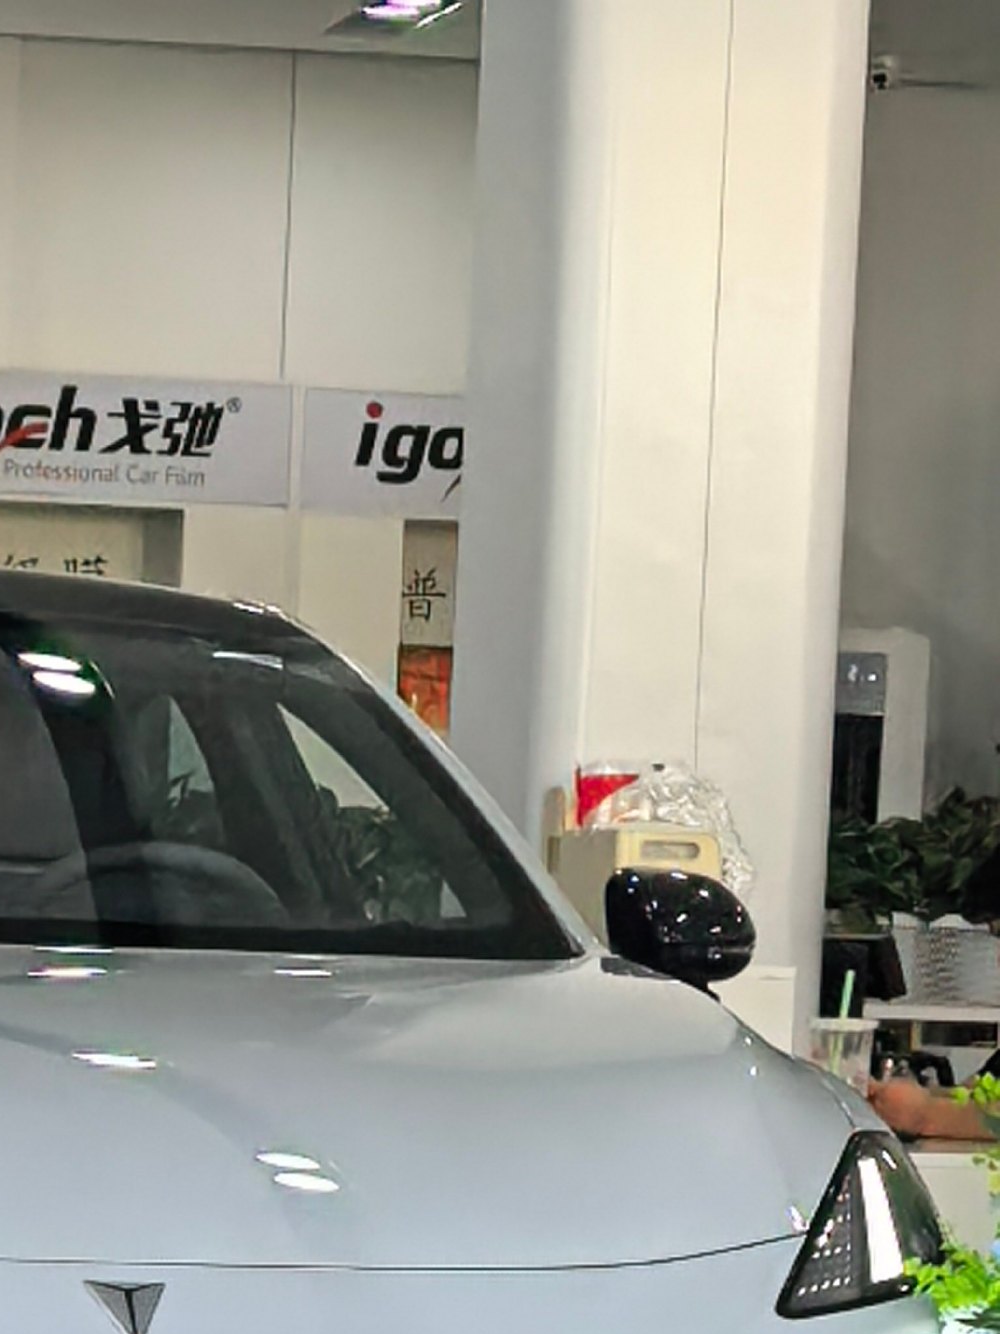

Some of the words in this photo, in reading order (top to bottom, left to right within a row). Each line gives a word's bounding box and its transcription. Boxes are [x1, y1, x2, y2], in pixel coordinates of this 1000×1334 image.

[3, 458, 120, 483] Professional
[126, 464, 158, 485] Car
[165, 466, 206, 488] Film
[401, 567, 447, 622] 普
